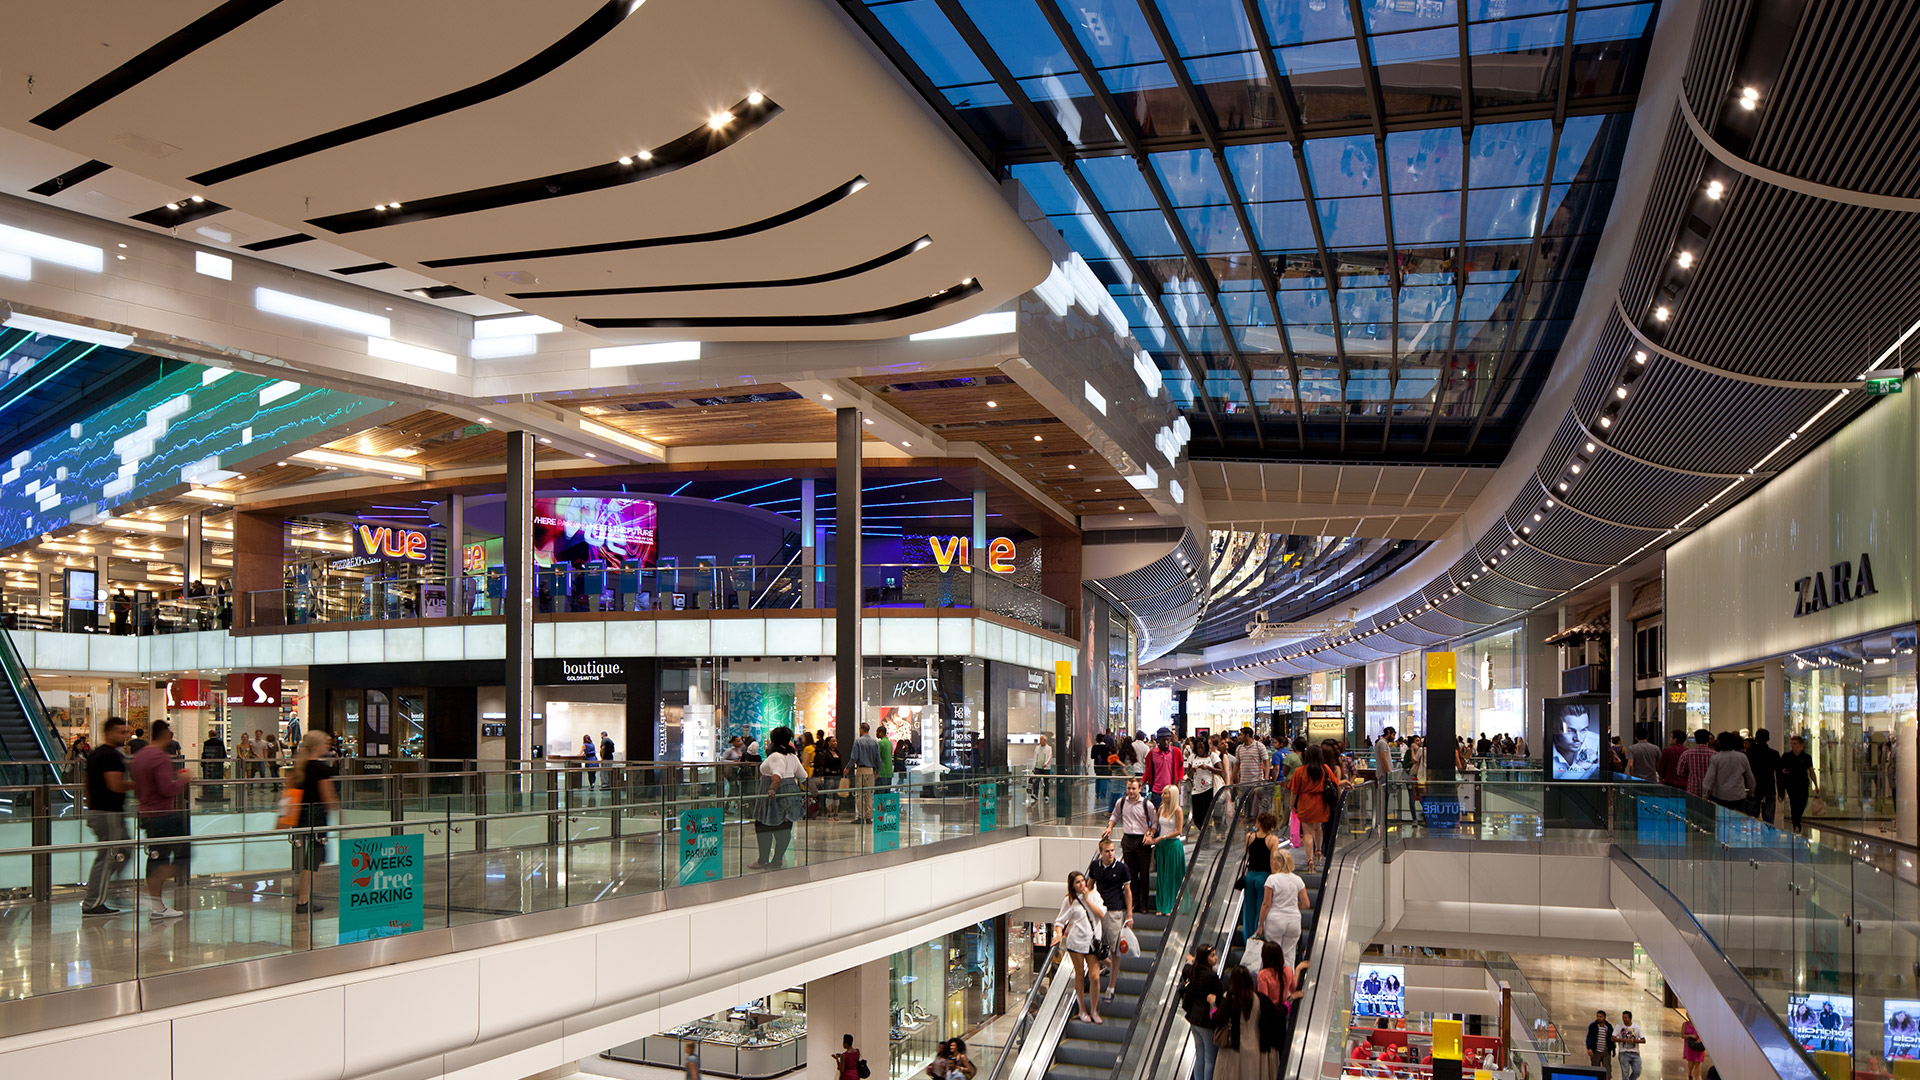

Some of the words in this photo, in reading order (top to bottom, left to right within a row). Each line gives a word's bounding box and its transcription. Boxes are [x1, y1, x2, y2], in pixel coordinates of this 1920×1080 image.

[1793, 552, 1879, 618] ZARA
[563, 660, 624, 678] boutique.
[180, 699, 207, 707] s.wear
[876, 822, 897, 832] PARKING
[697, 834, 718, 849] free
[685, 846, 718, 860] PARKING
[350, 851, 372, 888] 2
[367, 855, 413, 871] WEEKS
[373, 870, 414, 891] free
[350, 887, 413, 908] PARKING
